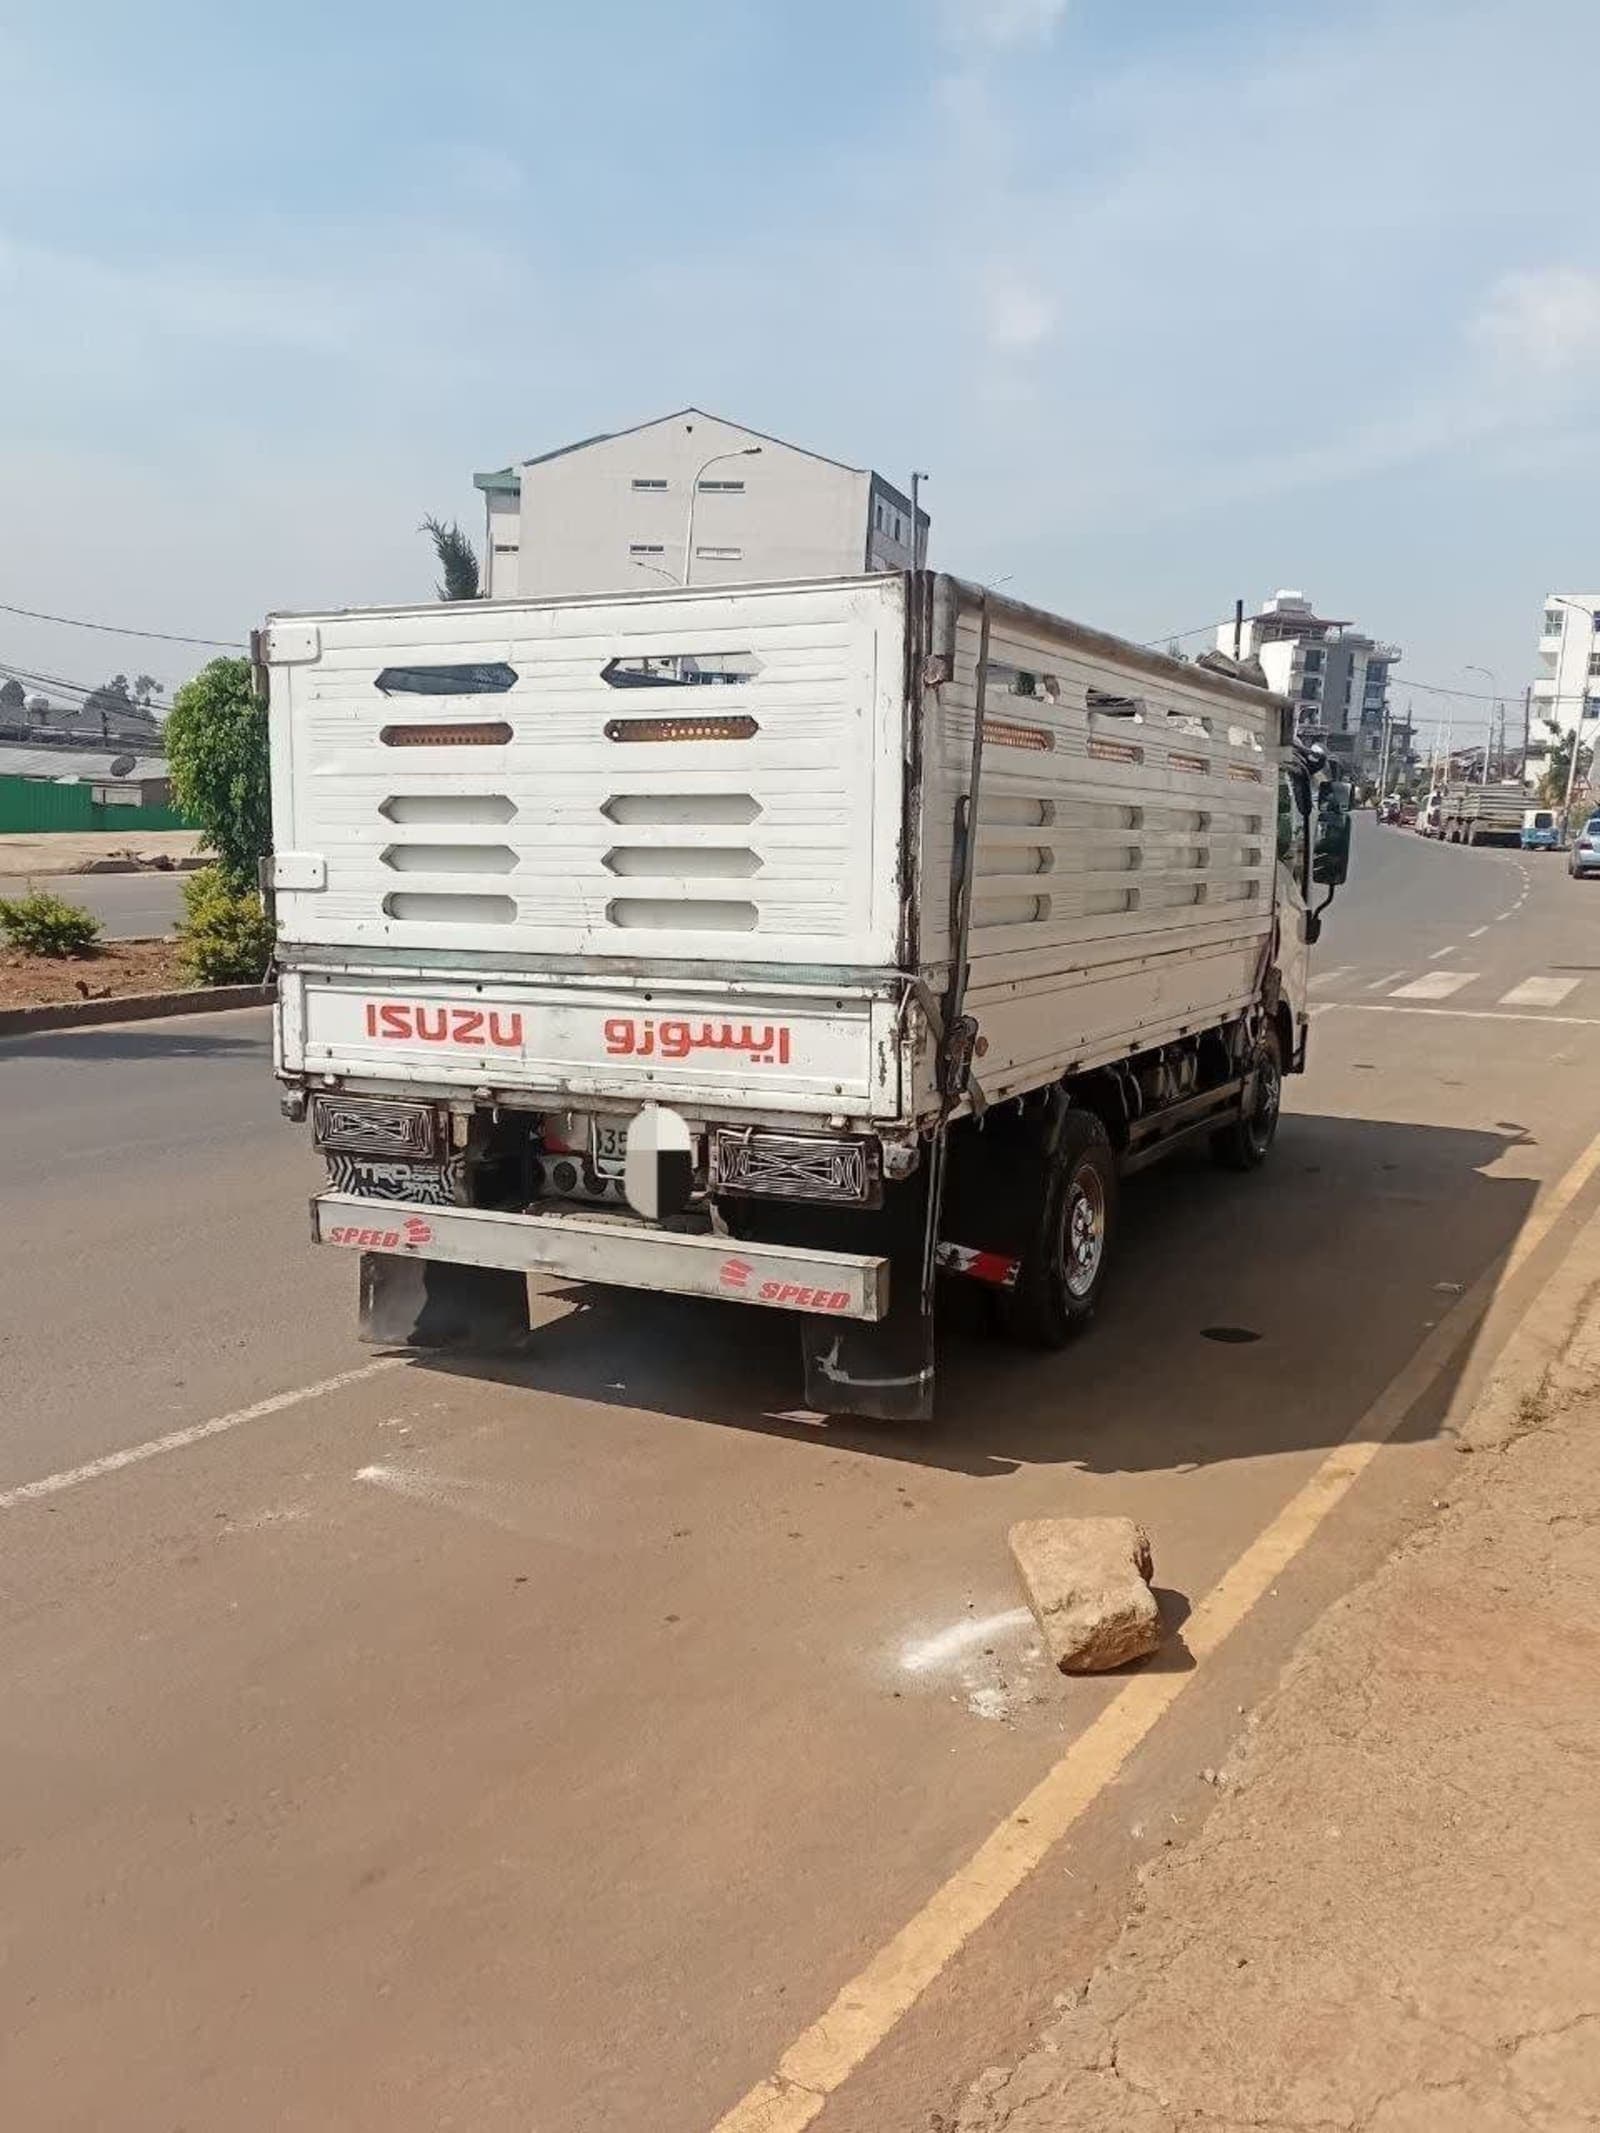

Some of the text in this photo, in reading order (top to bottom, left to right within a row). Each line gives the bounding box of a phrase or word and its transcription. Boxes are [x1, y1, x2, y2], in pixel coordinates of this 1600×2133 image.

[366, 1004, 523, 1047] ISUZU
[604, 1019, 790, 1064] ايسوزو
[596, 1128, 627, 1156] 35
[331, 1227, 400, 1248] SPEED
[759, 1282, 850, 1309] SPEED
